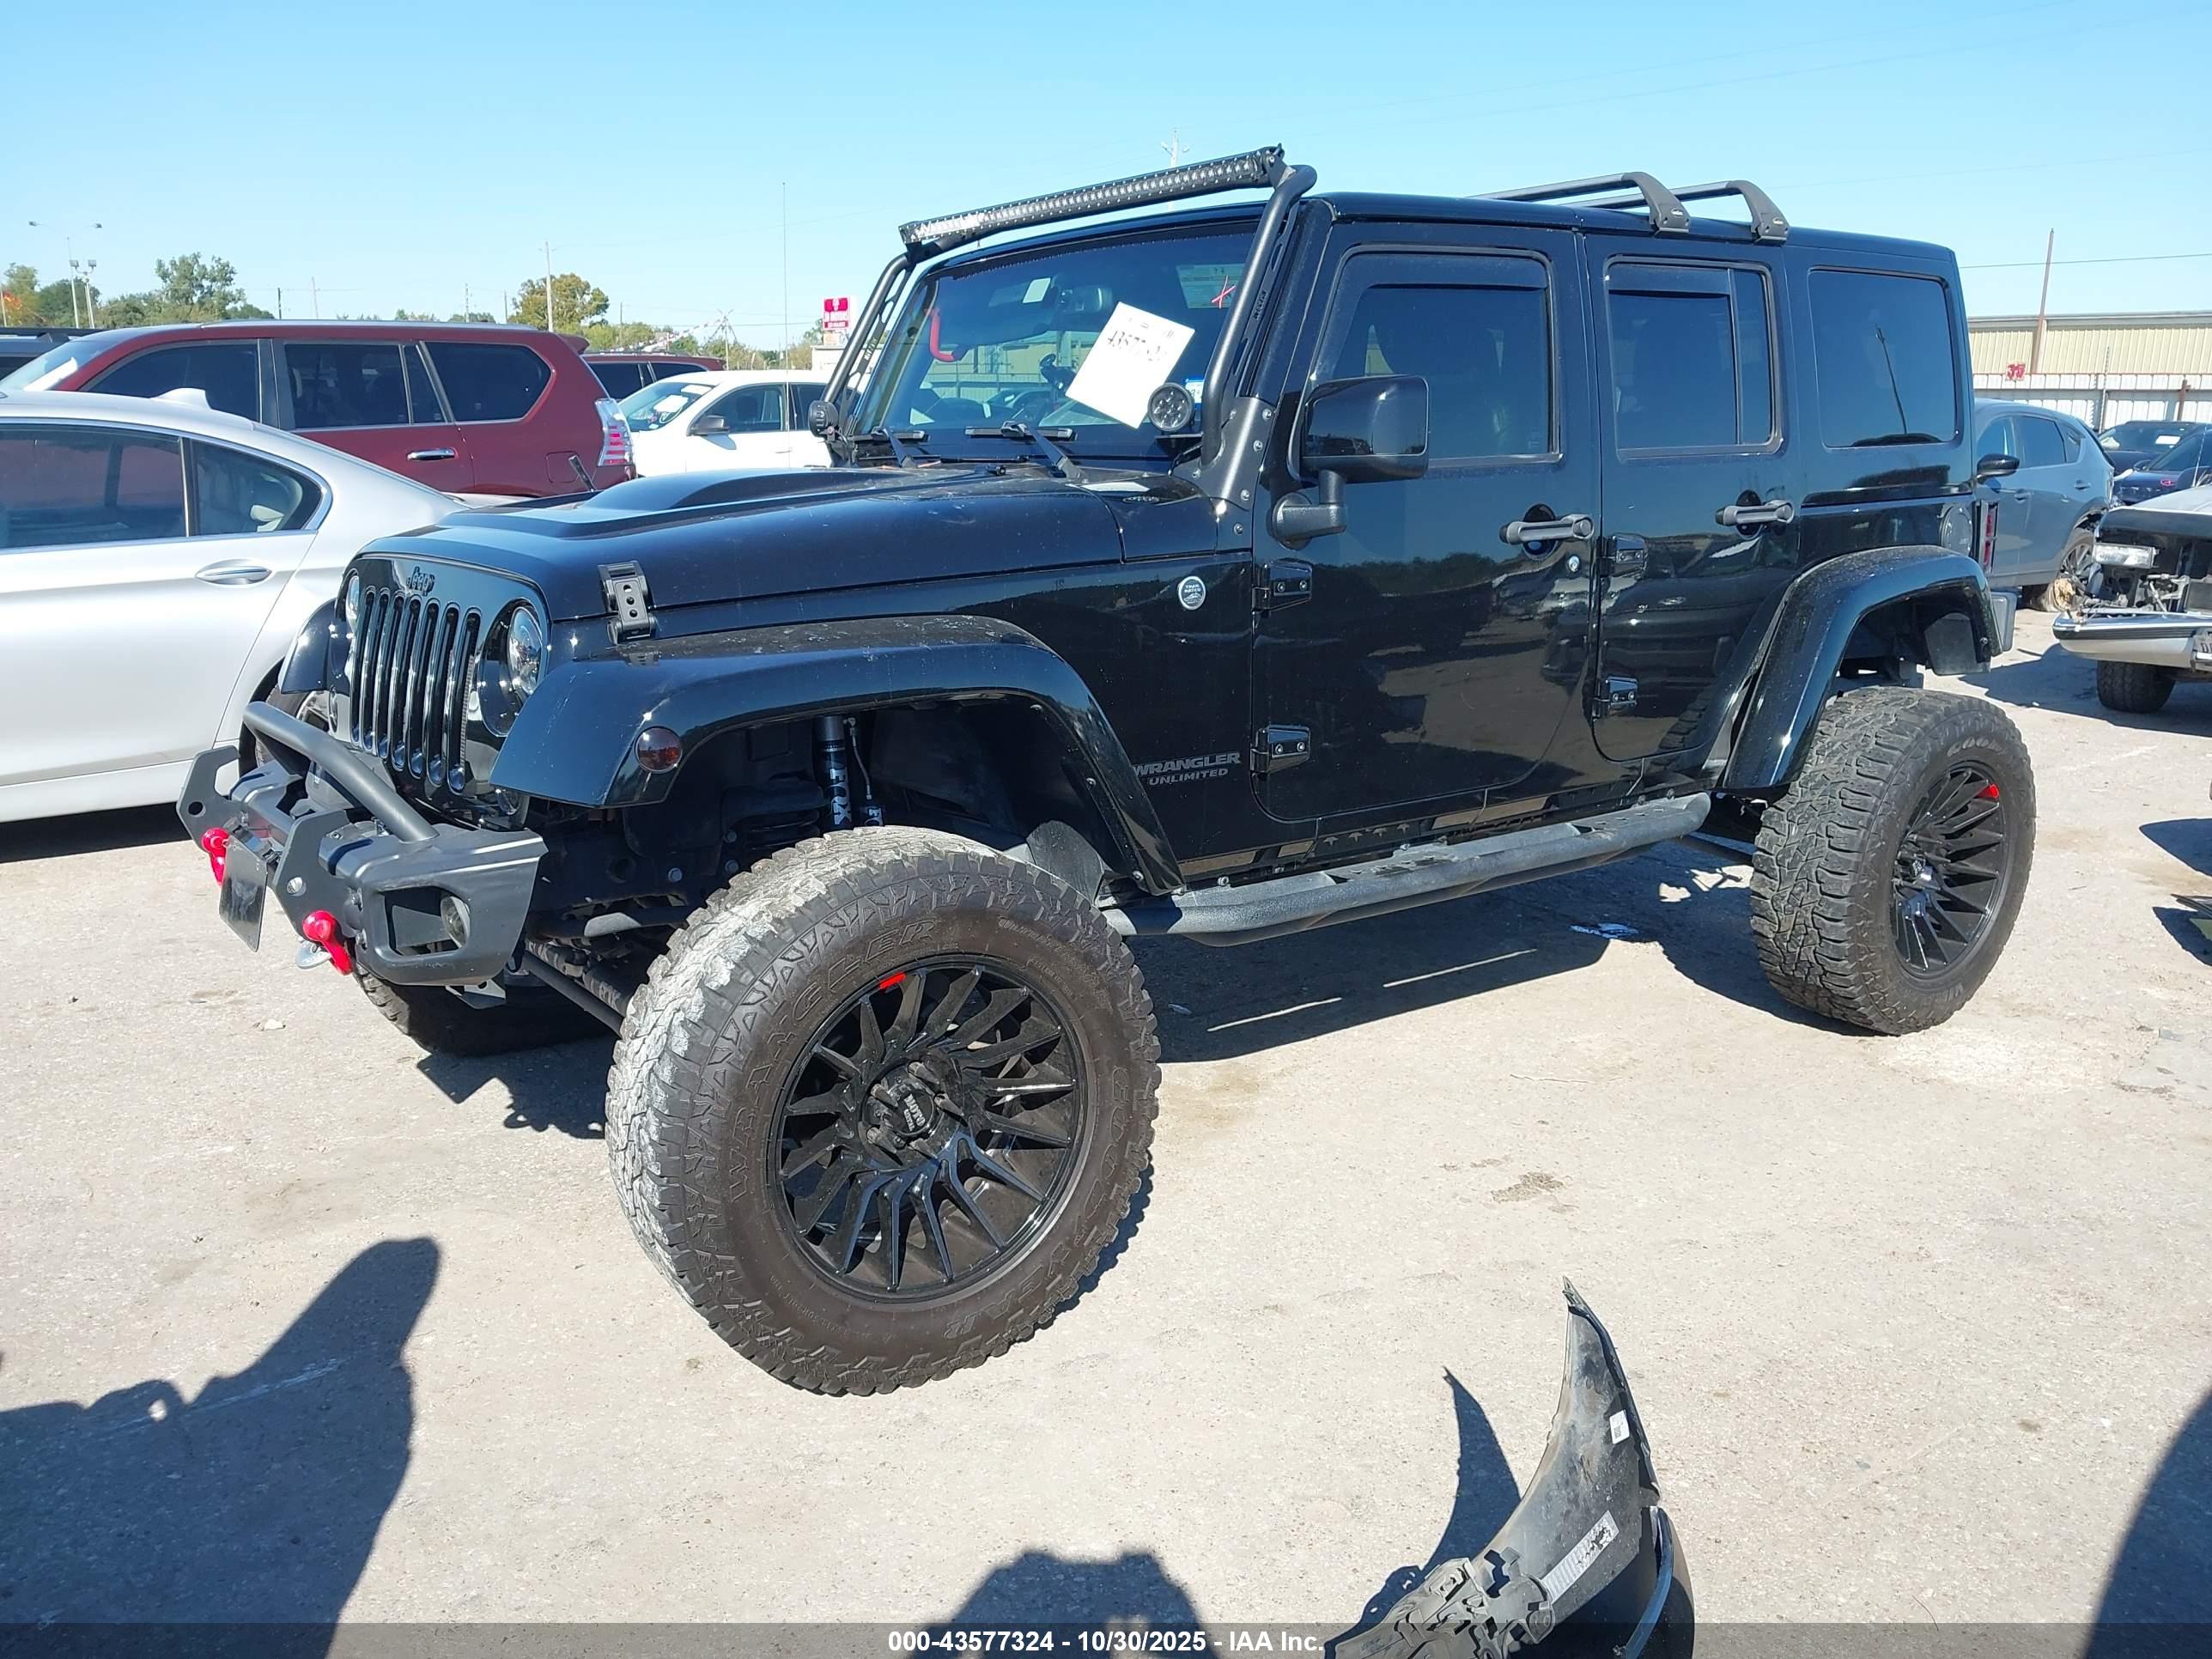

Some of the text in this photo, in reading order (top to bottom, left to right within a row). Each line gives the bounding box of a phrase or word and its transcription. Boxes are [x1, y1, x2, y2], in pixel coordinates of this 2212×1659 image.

[407, 566, 435, 597] Jeep
[1133, 752, 1241, 776] WRANGLER
[1149, 769, 1229, 785] UNLIMITED
[827, 768, 853, 826] FOX
[866, 807, 884, 826] FO
[728, 920, 937, 1203] WRANGLER
[903, 1093, 926, 1127] MOTO
